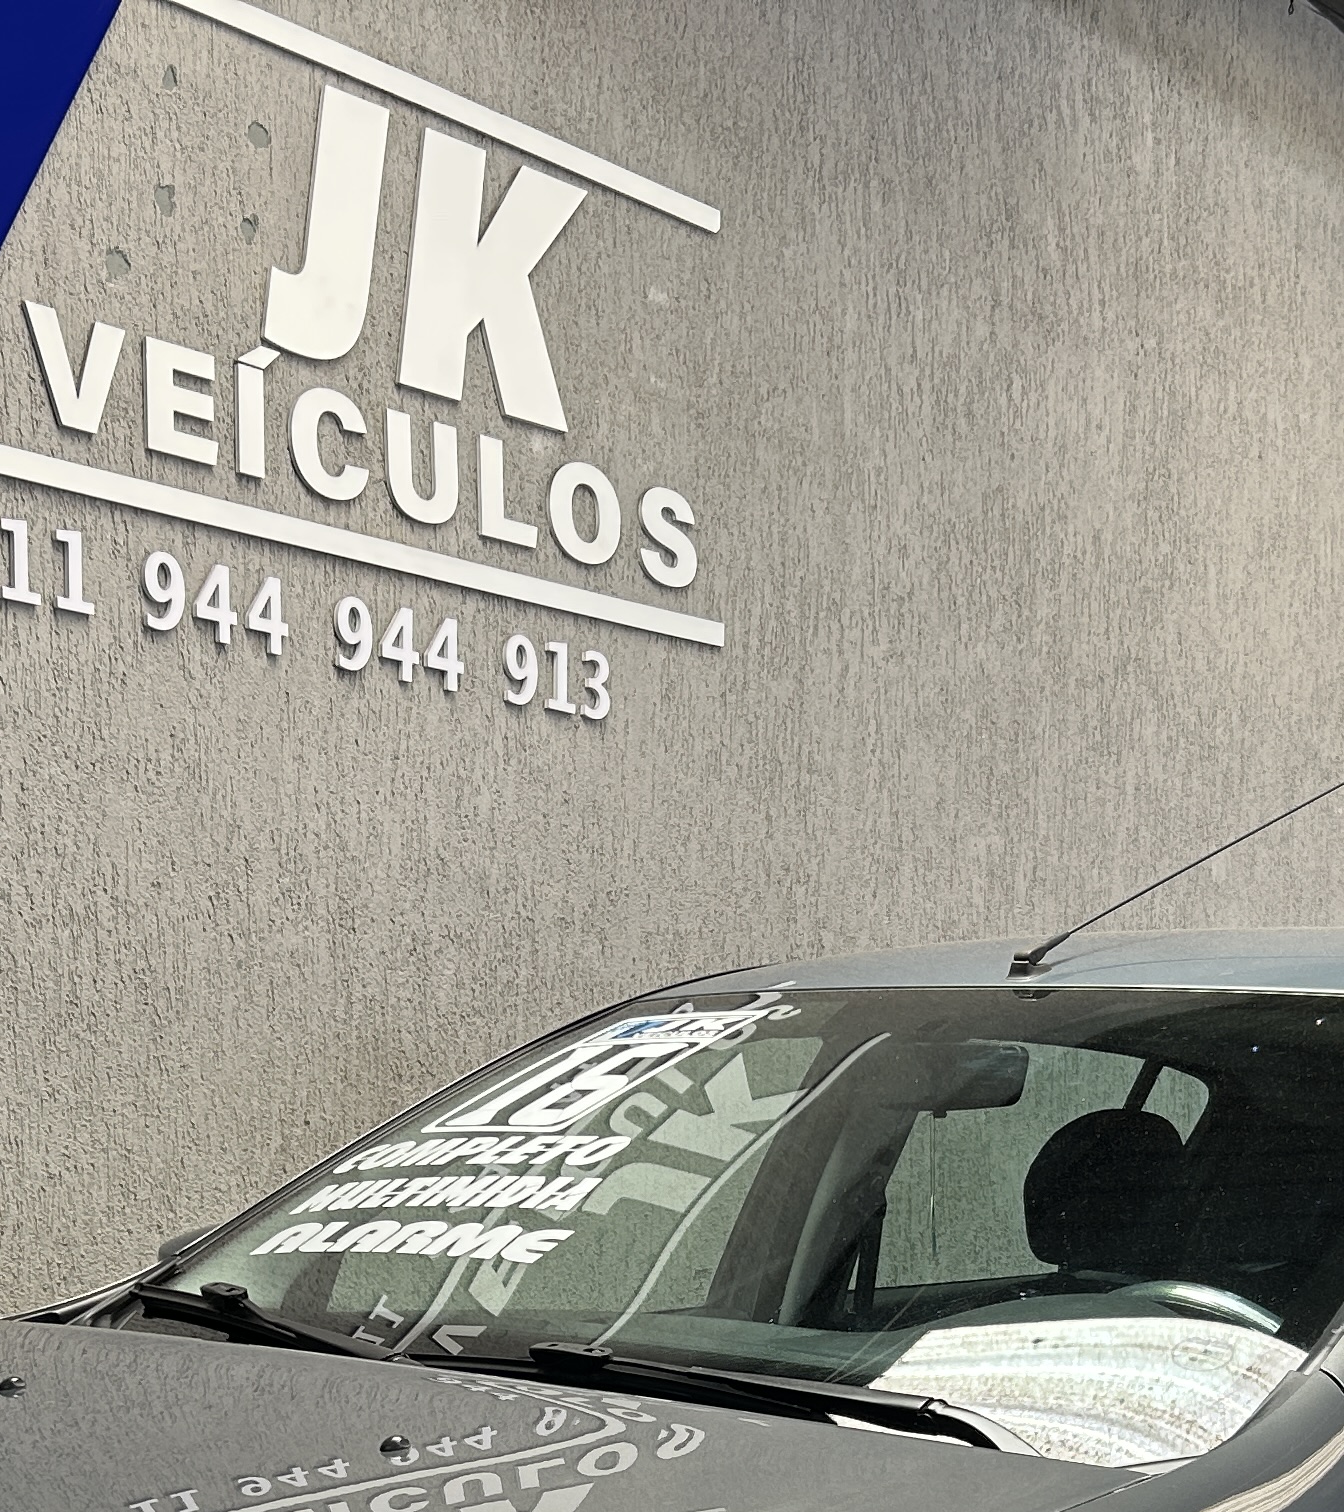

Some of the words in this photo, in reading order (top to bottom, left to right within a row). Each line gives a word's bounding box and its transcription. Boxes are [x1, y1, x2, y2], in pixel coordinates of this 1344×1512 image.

[264, 85, 588, 433] JK
[23, 299, 699, 588] VEÍCULOS
[0, 517, 96, 617] 11
[143, 550, 290, 657] 944
[335, 596, 464, 694] 944
[504, 634, 613, 723] 913
[249, 1220, 575, 1264] ALARME
[333, 1136, 632, 1174] COMPLETO
